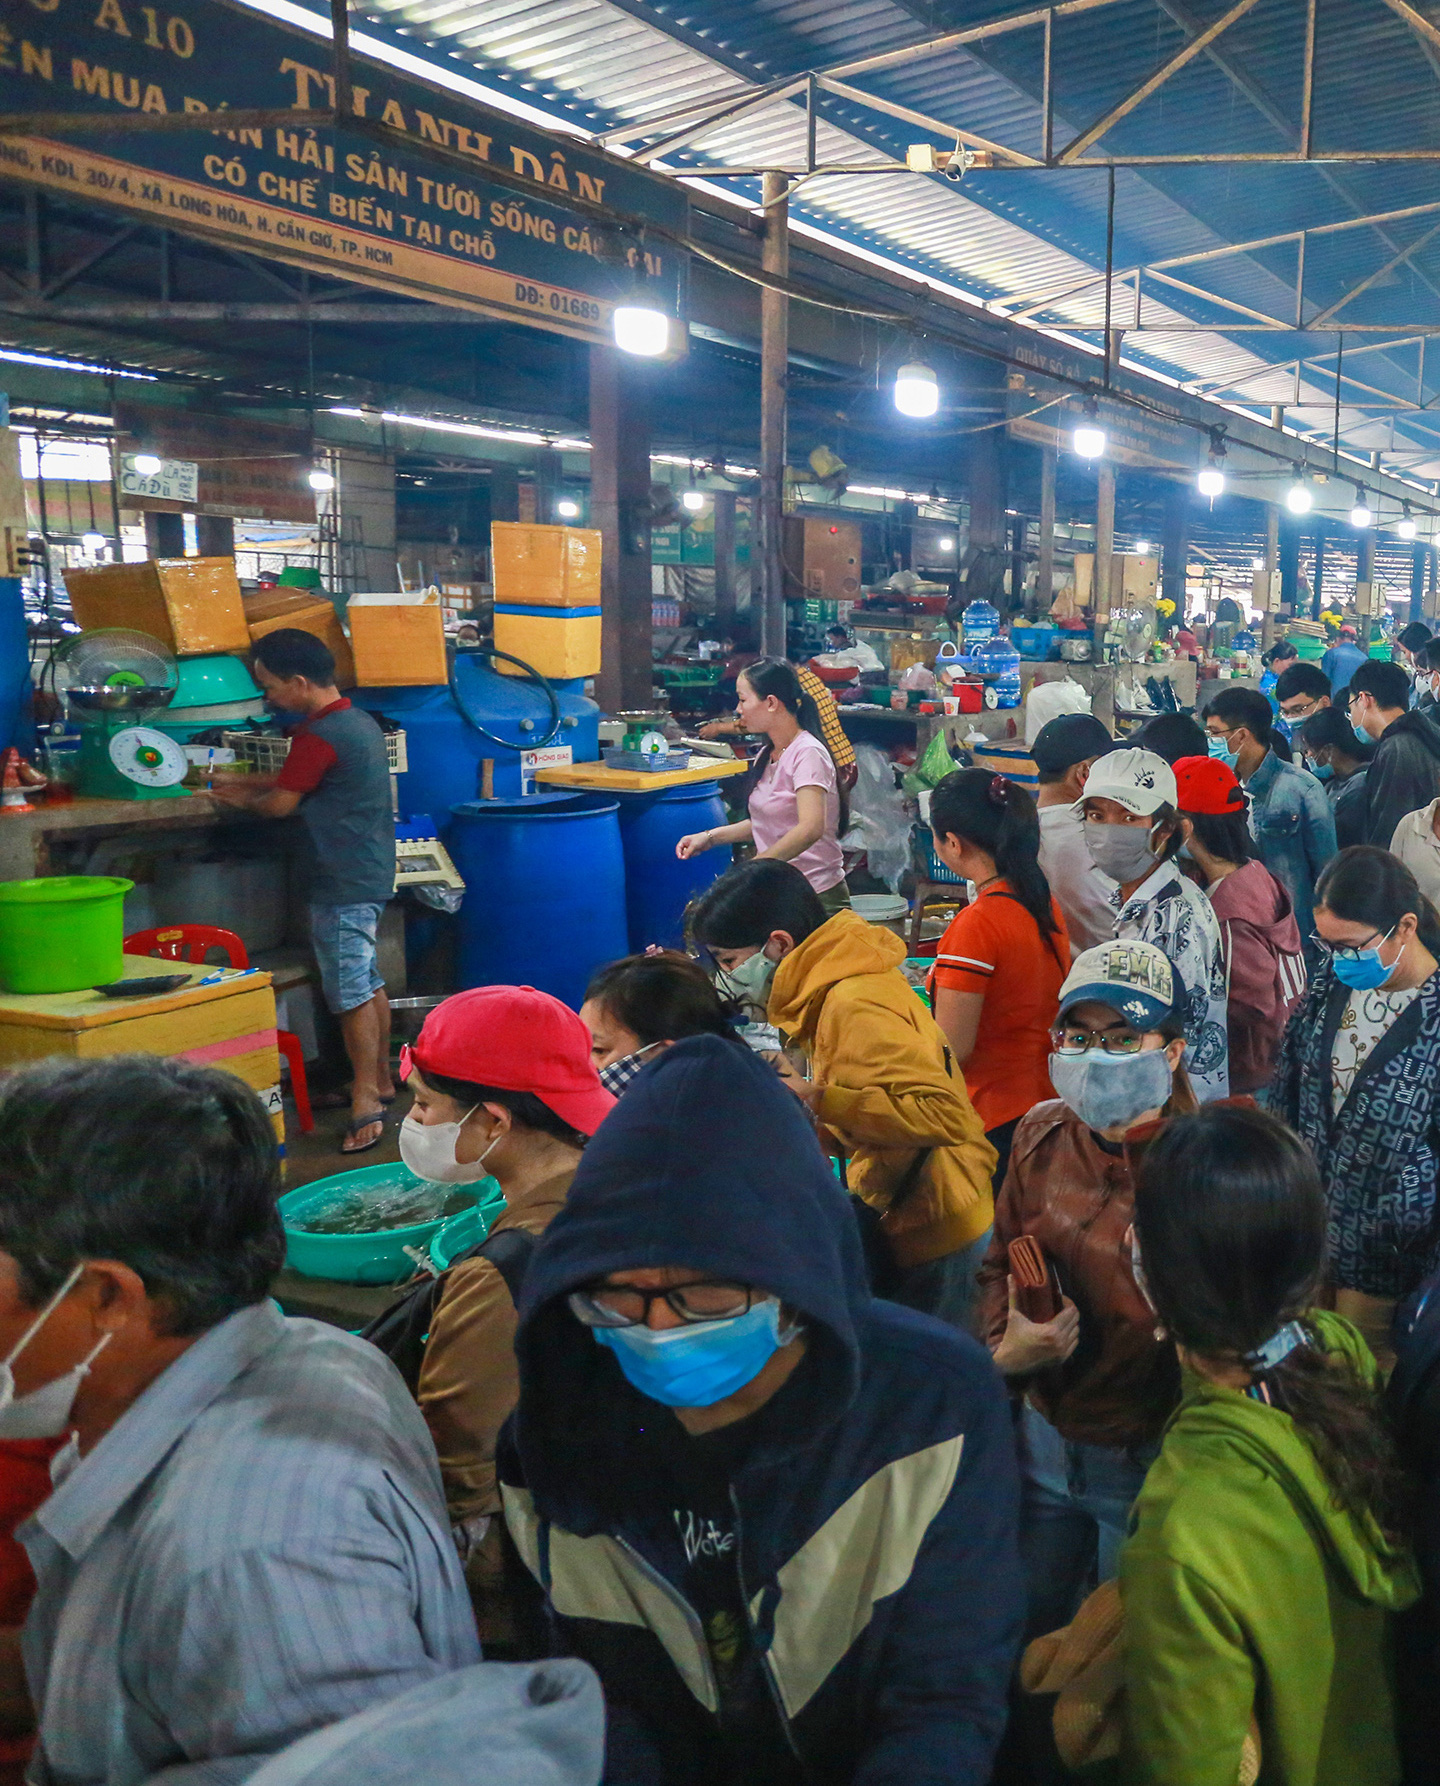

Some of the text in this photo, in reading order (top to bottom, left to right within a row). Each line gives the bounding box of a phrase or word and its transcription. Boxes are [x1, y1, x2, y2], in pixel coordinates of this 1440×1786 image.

[94, 0, 196, 59] A10
[71, 58, 168, 115] MUA
[276, 127, 336, 174] HẢI
[345, 151, 409, 197] SẢN
[416, 176, 481, 220] TƯƠI
[489, 201, 557, 244] SỐNG
[168, 190, 212, 217] LONG
[256, 215, 273, 234] H.
[340, 238, 361, 258] TP.
[364, 245, 394, 266] HCM
[203, 154, 497, 261] CÓ CHẾ BIẾN TẠI CHỖ
